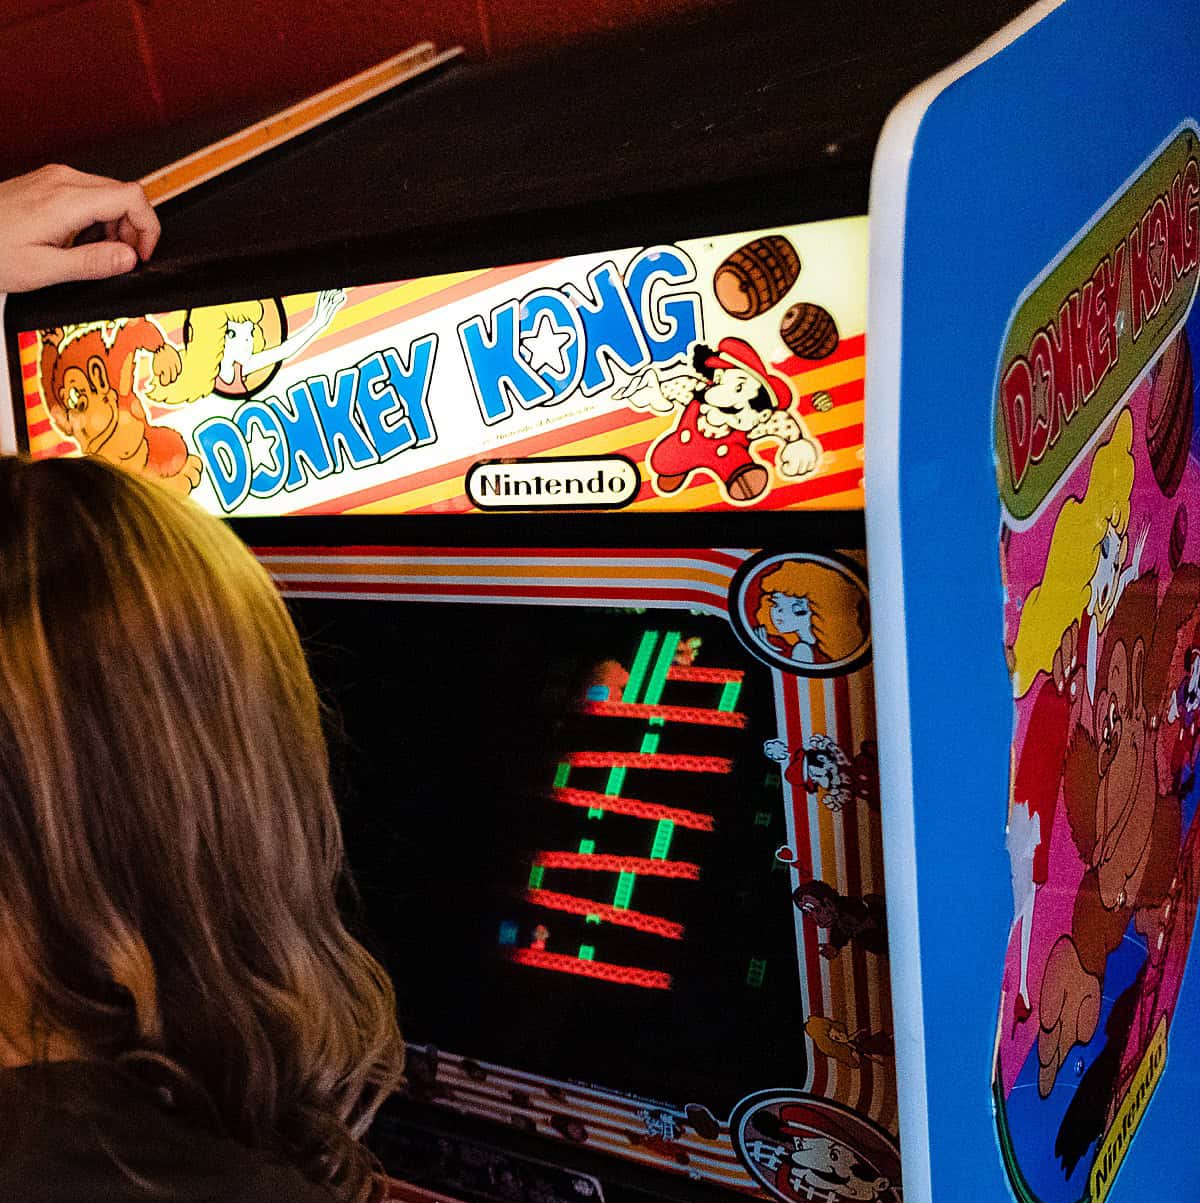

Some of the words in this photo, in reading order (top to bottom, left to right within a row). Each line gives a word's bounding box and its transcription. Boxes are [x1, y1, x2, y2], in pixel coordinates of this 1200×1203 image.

[193, 333, 439, 512] DONKEY
[457, 245, 705, 425] KONG
[1002, 242, 1126, 494] DONKEY
[1128, 159, 1200, 343] KONG
[479, 470, 626, 497] Nintendo
[1094, 1044, 1162, 1199] Nintendo
